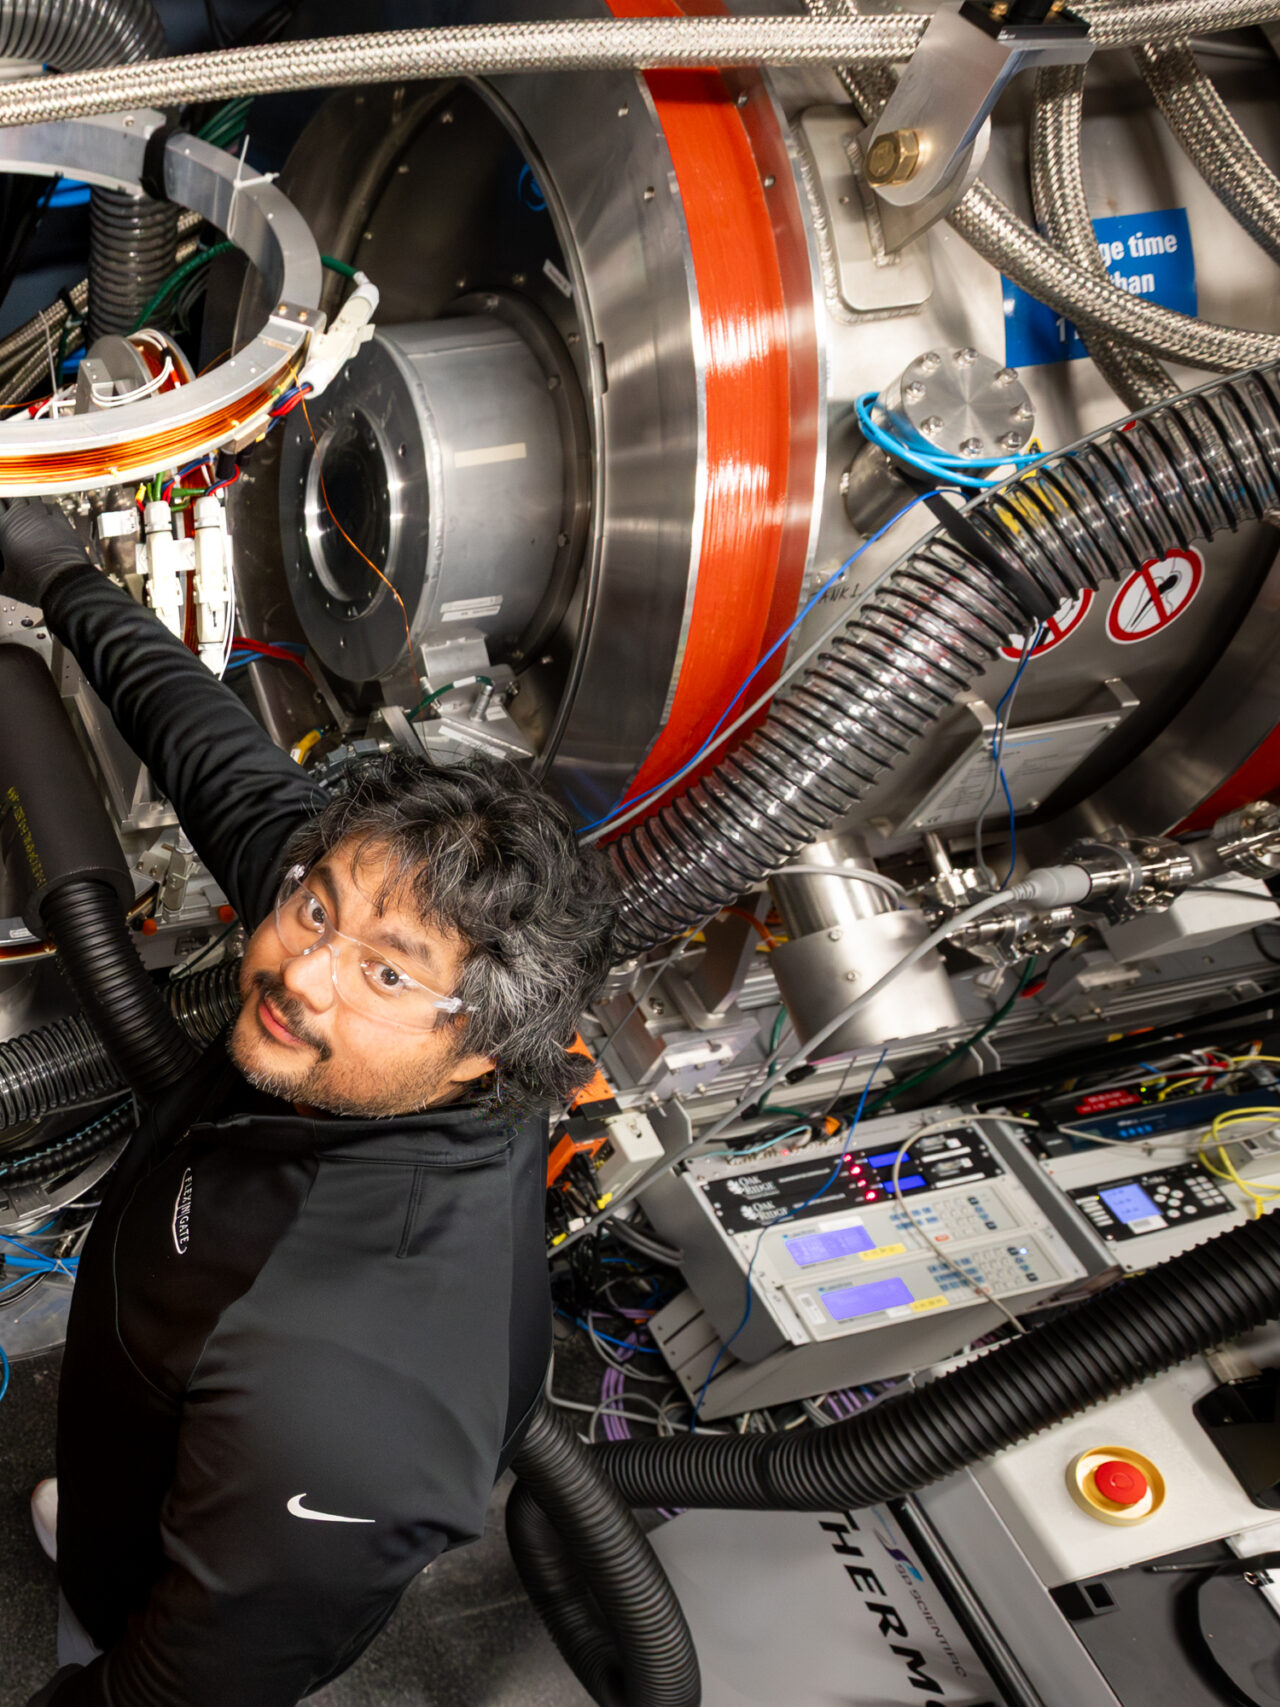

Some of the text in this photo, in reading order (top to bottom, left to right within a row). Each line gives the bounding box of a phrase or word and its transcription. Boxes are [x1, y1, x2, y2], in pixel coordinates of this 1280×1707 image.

[1127, 232, 1178, 259] time
[1055, 317, 1066, 342] 1
[895, 1563, 968, 1678] SP SCIENTIFIC
